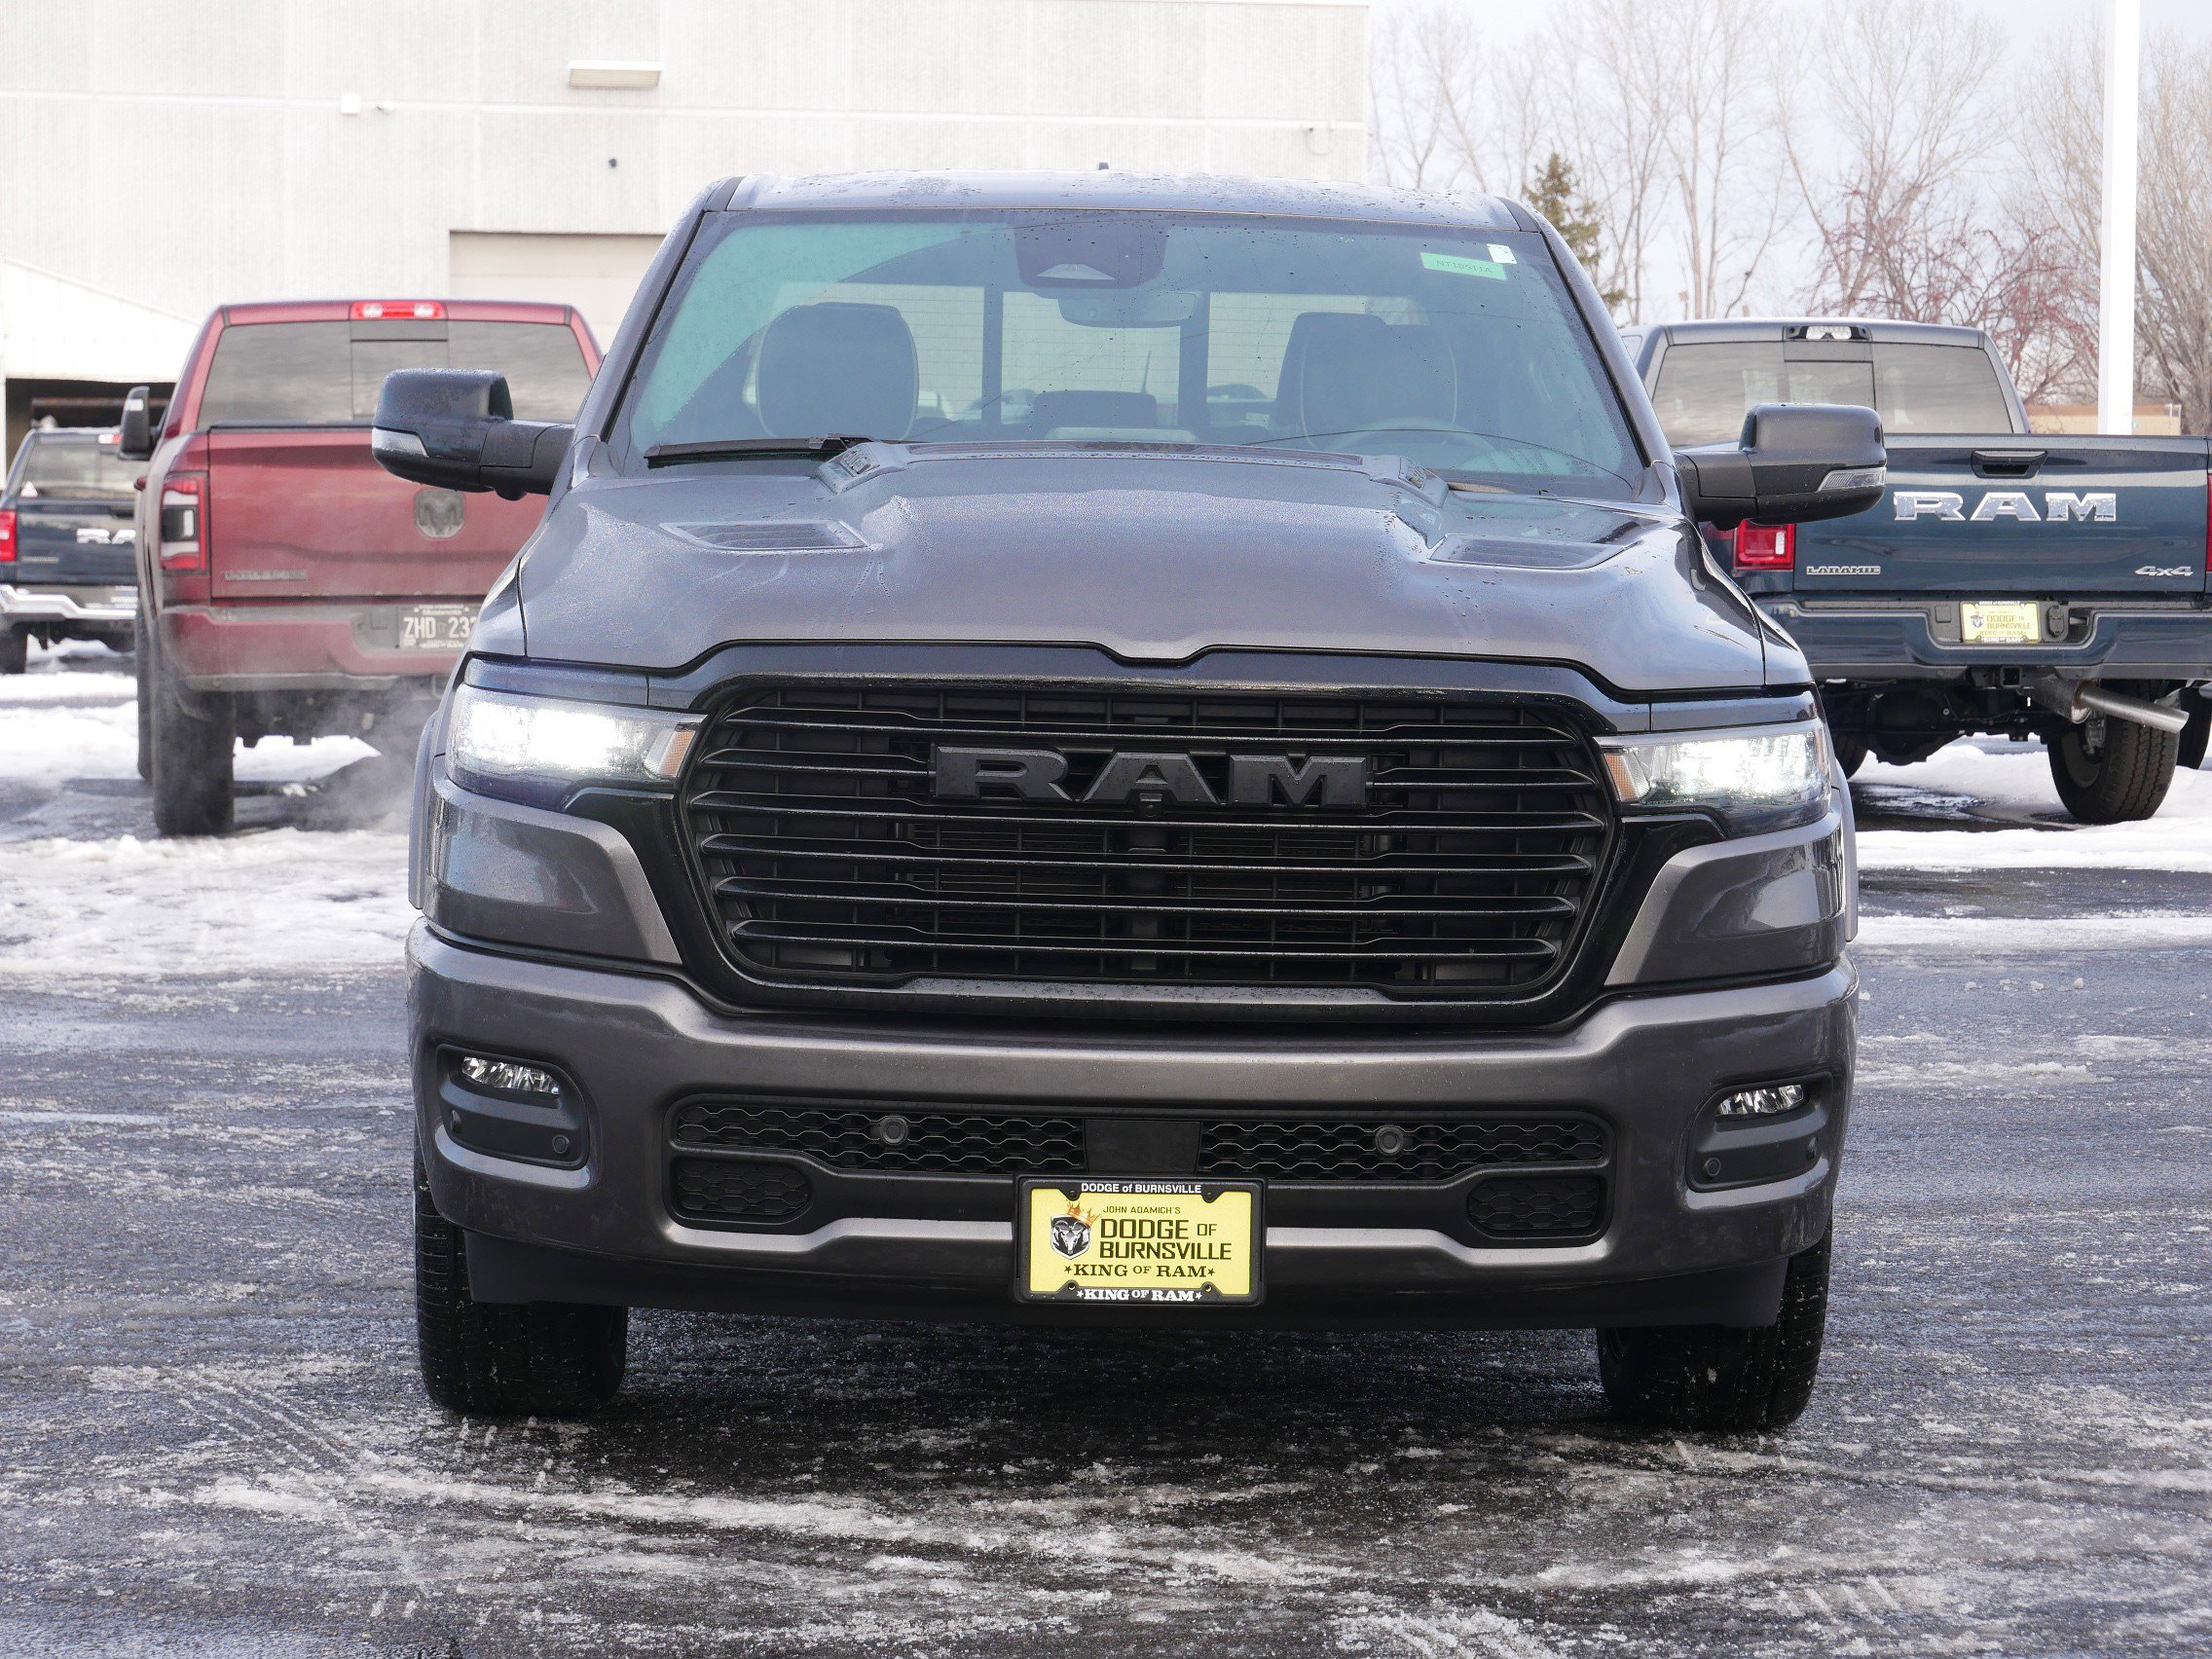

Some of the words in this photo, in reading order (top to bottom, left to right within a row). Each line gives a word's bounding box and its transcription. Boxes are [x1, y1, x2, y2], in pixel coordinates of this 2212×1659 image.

[1894, 491, 2117, 521] RAM
[77, 529, 136, 544] RA
[1806, 566, 1881, 575] LARAMIE
[2134, 566, 2194, 576] 4x4
[403, 616, 437, 639] ZHD
[448, 616, 477, 639] 23
[935, 745, 1367, 808] RAM
[1081, 1182, 1120, 1193] DODGE
[1122, 1183, 1132, 1193] of
[1135, 1184, 1202, 1194] BURNSVILLE
[1102, 1205, 1127, 1214] JOHN
[1130, 1206, 1181, 1215] ADAMICH'S
[1100, 1218, 1190, 1239] DODGE
[1197, 1223, 1217, 1236] OF
[1099, 1241, 1233, 1260] BURNSVILLE
[1073, 1264, 1128, 1276] KING
[1133, 1265, 1151, 1274] OF
[1156, 1265, 1207, 1277] RAM
[1084, 1288, 1129, 1301] KING
[1132, 1289, 1150, 1299] OF
[1151, 1289, 1195, 1302] RAM
